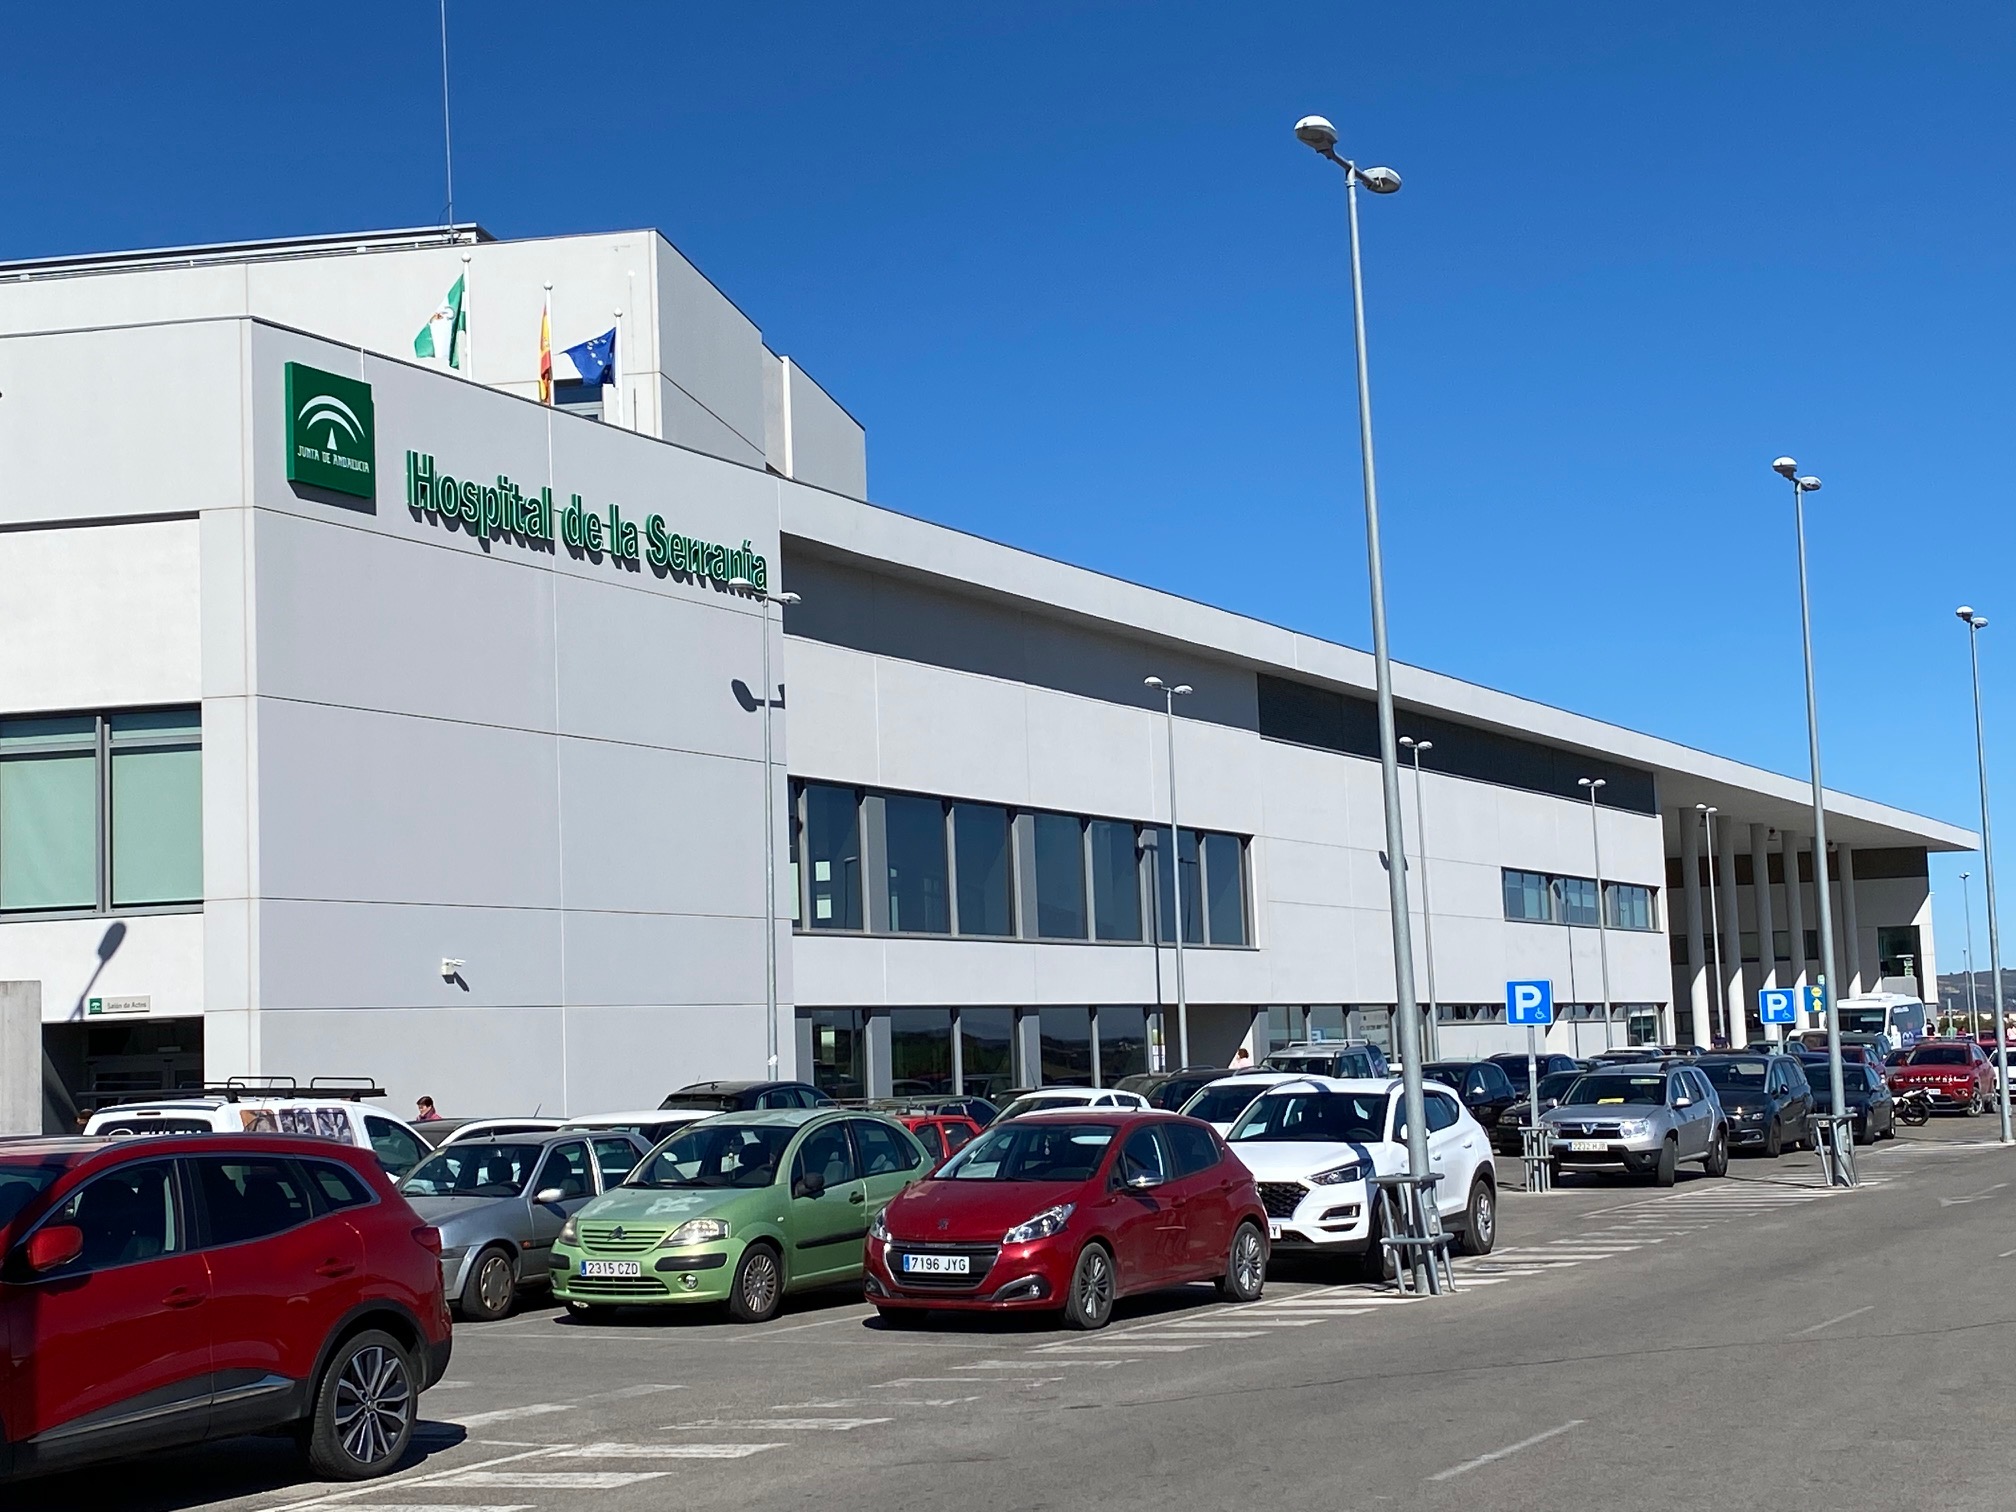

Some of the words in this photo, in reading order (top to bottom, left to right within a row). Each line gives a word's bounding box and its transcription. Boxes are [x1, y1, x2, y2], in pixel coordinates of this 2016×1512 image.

[297, 445, 320, 461] JUNTA
[321, 451, 331, 464] DE
[332, 454, 370, 473] ANDALUCIA
[407, 450, 554, 539] Hospital
[562, 493, 602, 551] de
[609, 503, 640, 560] la
[646, 513, 768, 592] Serranía
[1515, 985, 1542, 1020] P
[1766, 993, 1788, 1020] P
[588, 1262, 615, 1275] 2315
[618, 1262, 638, 1275] CZD
[911, 1256, 940, 1271] 7196
[944, 1258, 966, 1272] JYG
